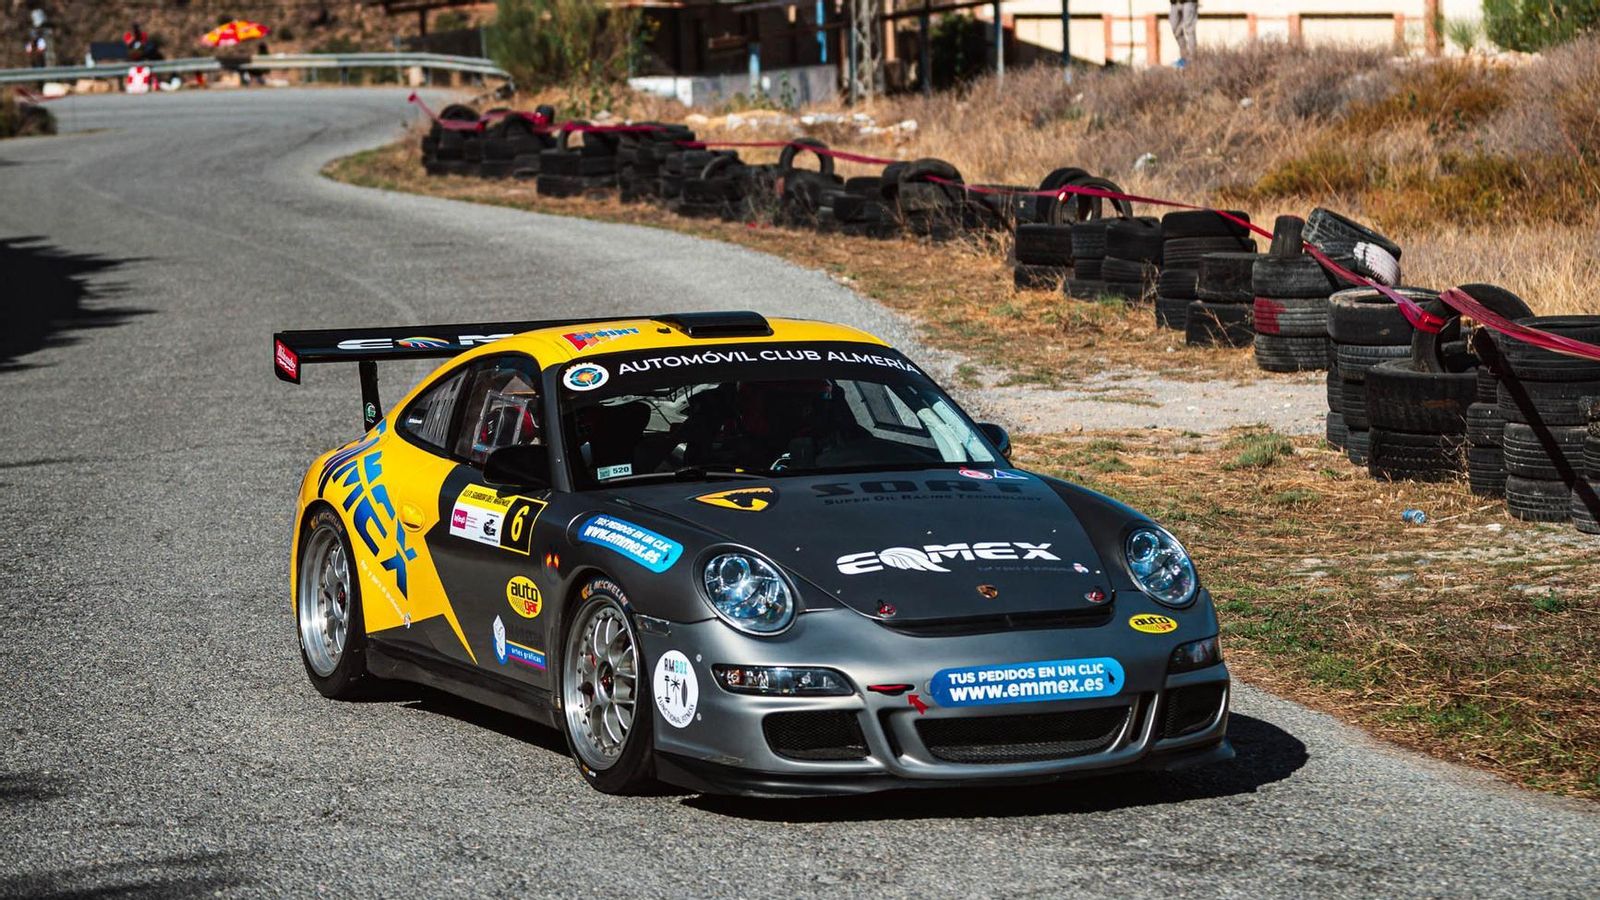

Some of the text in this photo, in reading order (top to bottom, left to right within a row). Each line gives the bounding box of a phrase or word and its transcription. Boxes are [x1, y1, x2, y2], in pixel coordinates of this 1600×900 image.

[618, 350, 922, 376] AUTOMÓVIL CLUB ALMERÍA
[612, 466, 630, 474] 520
[824, 496, 871, 506] SUPER
[873, 494, 896, 502] OIL
[901, 493, 953, 502] RACING
[511, 505, 530, 541] 6
[595, 517, 672, 552] TUS PEDIDOS EN UN CLIC
[584, 525, 662, 564] www.emmex.es
[511, 582, 538, 602] auto
[593, 579, 629, 606] MICHELIN
[524, 600, 537, 615] gar
[1134, 616, 1170, 625] auto
[948, 663, 1104, 685] TUS PEDIDOS EN UN CLIC
[949, 677, 1104, 702] www.emmex.es
